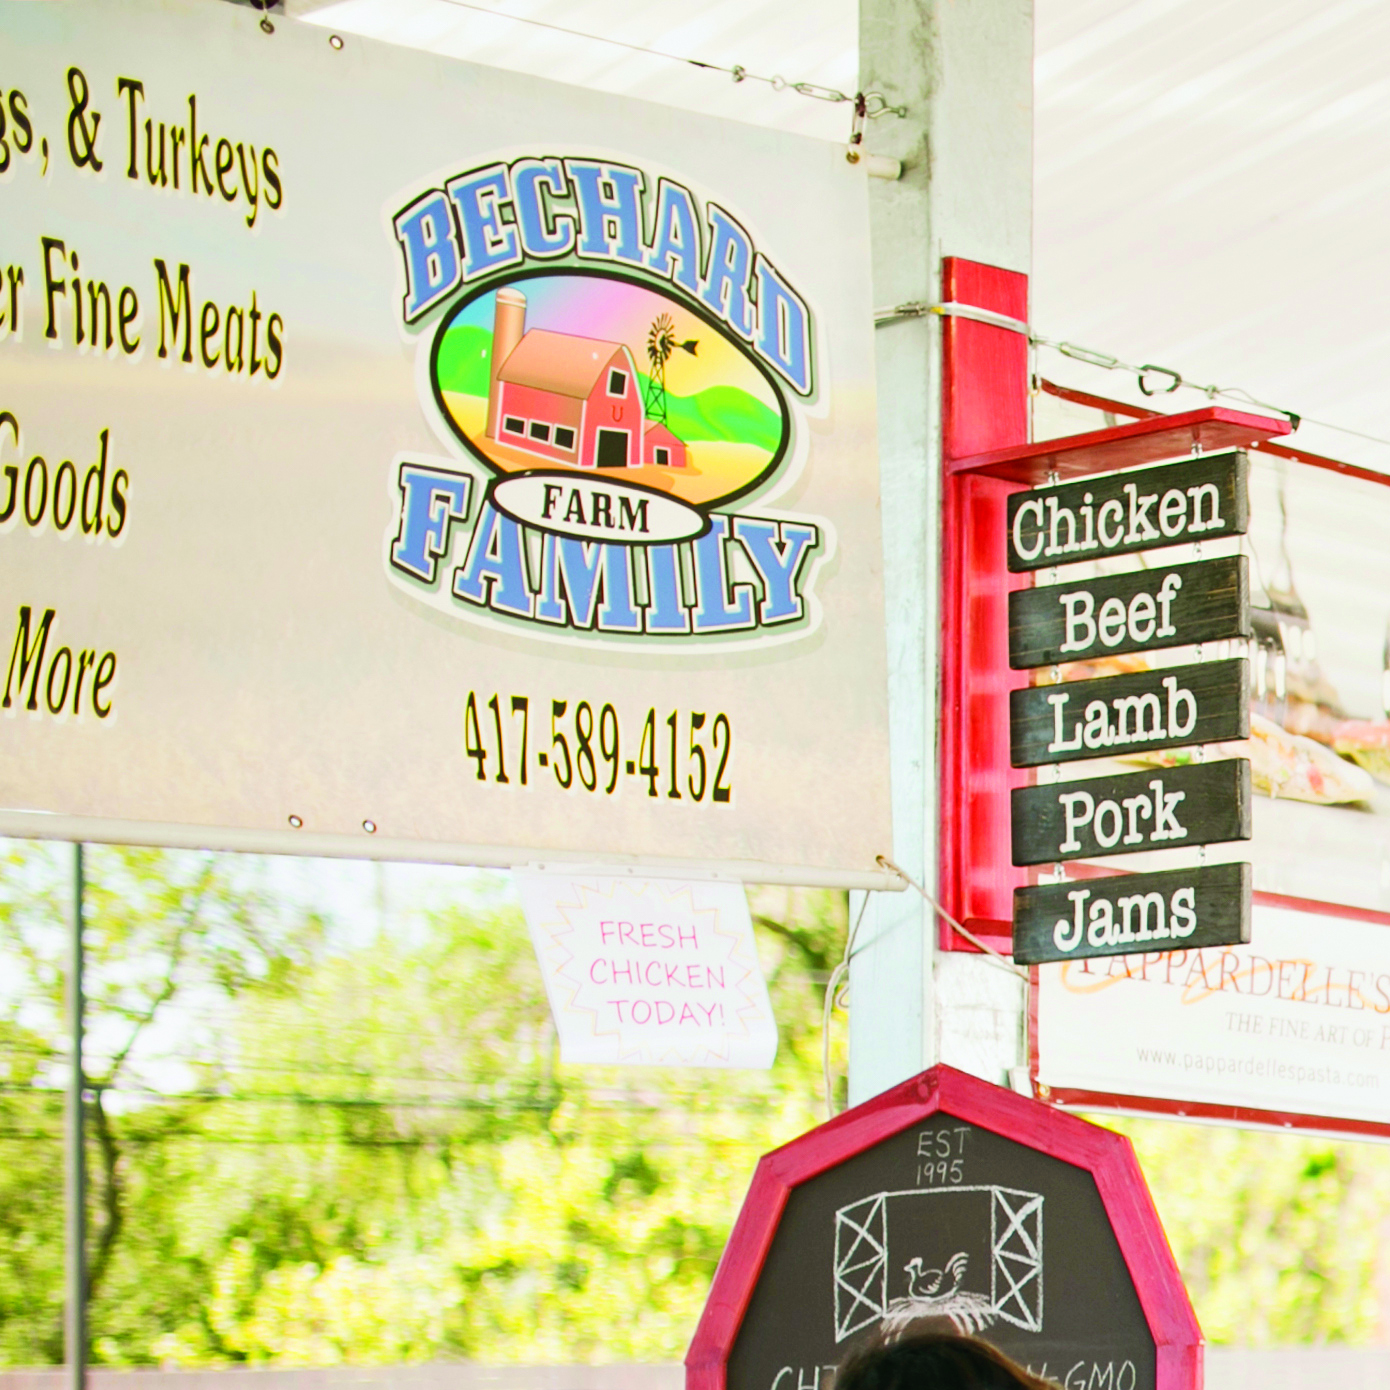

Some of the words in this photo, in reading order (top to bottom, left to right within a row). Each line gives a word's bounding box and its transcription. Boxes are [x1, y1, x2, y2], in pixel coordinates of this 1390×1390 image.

[66, 67, 103, 172] &
[117, 77, 283, 229] Turkeys
[41, 236, 141, 354] Fine
[153, 258, 284, 380] Meats
[391, 156, 814, 398] BECHARD
[540, 483, 651, 533] FARM
[1012, 481, 1226, 561] Chicken
[390, 462, 819, 635] FAMILY
[1058, 574, 1183, 653] Beef
[1, 606, 117, 718] More
[465, 691, 732, 803] 417-589-4152
[1047, 675, 1198, 754] Lamb
[1058, 780, 1188, 855] Pork
[600, 921, 698, 950] FRESH
[1053, 886, 1198, 953] Jams
[589, 957, 726, 990] CHICKEN
[606, 999, 727, 1027] TODAY!
[1225, 1011, 1264, 1035] THE
[1268, 1016, 1309, 1040] FINE
[1313, 1024, 1349, 1045] ART
[1352, 1028, 1377, 1048] OF
[1136, 1046, 1381, 1090] www.pappardellespasta.com
[916, 1159, 964, 1186] 1995
[917, 1126, 971, 1158] EST
